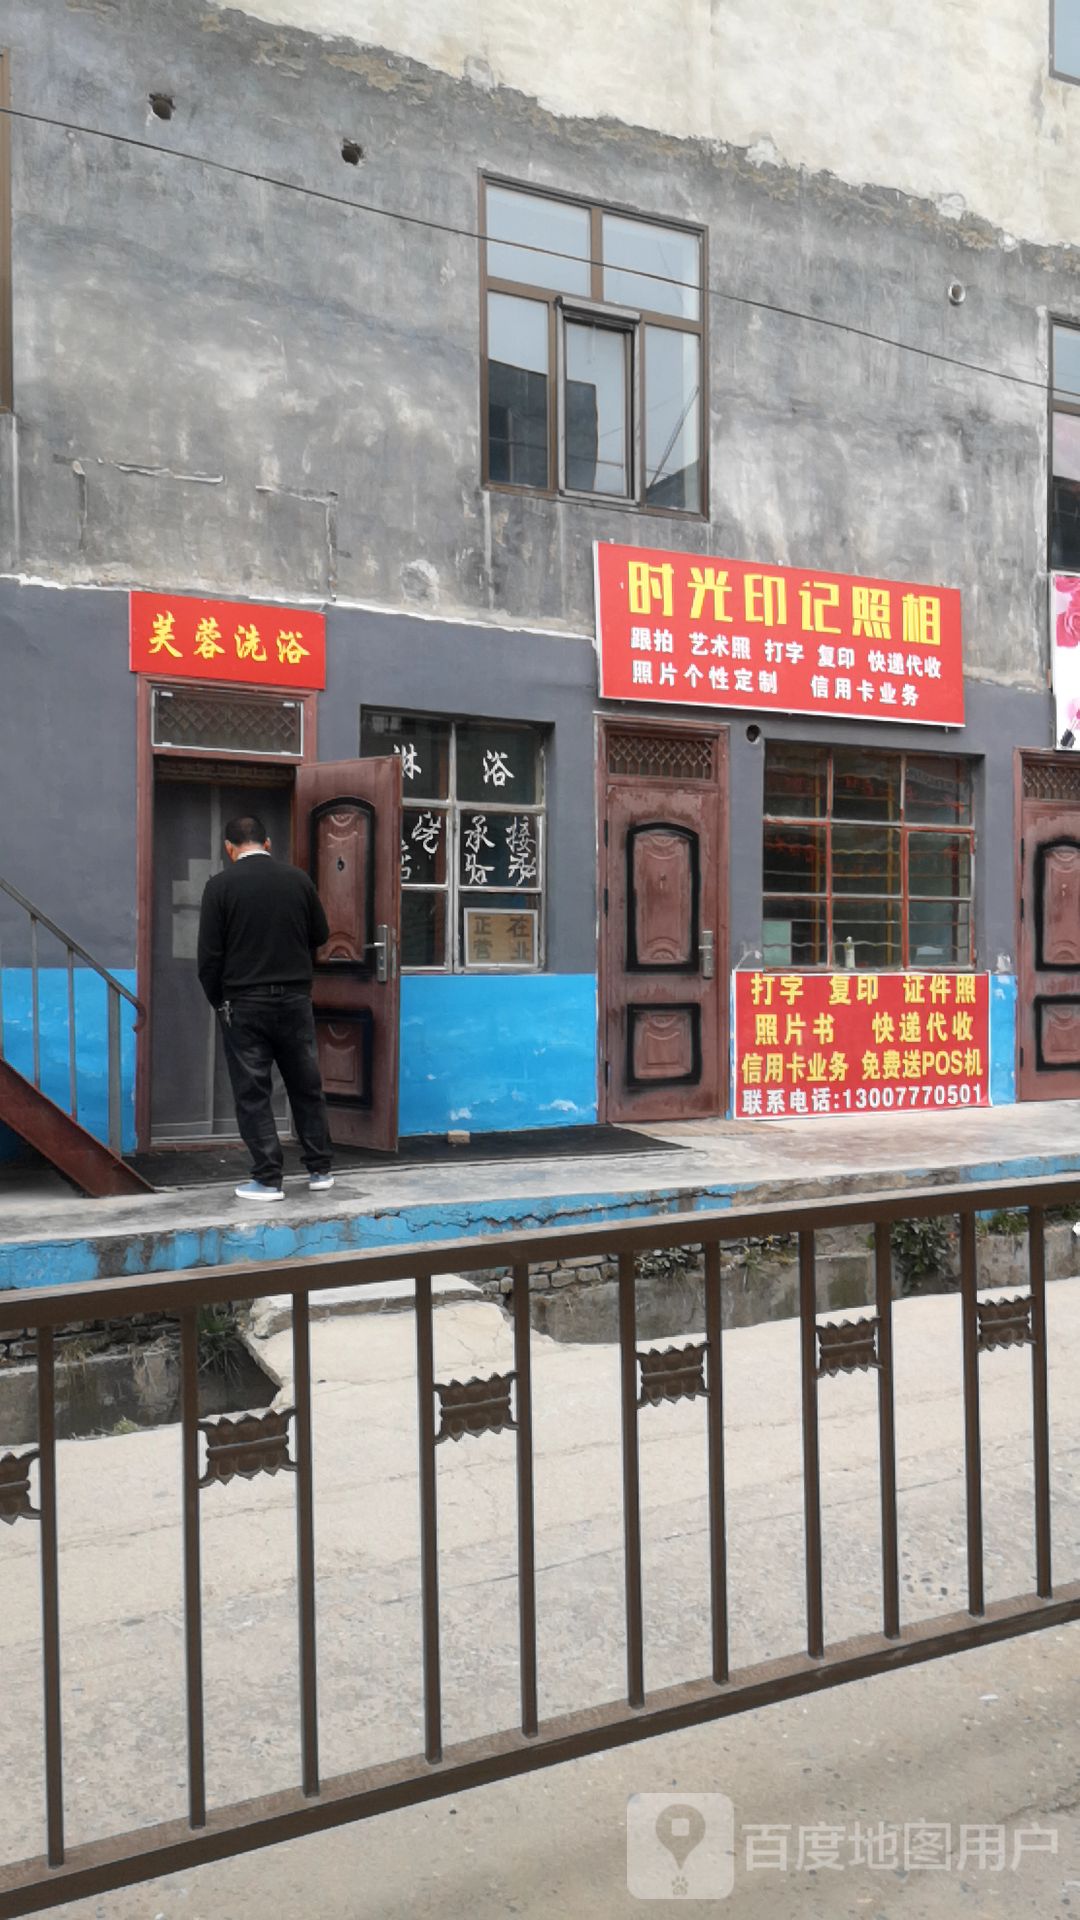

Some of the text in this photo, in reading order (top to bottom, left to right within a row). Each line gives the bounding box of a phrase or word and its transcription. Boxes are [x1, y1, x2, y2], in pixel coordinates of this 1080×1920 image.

[627, 560, 942, 646] 时光印记照相
[148, 610, 311, 664] 芙蓉洗浴
[630, 627, 943, 679] 跟拍 艺术照 打字 复印 快递代收
[632, 660, 920, 707] 照片个性定制 信用卡业务
[751, 973, 977, 1006] 打字 复印 证件照
[755, 1011, 974, 1046] 照片书 快递代收
[742, 1048, 983, 1085] 信用卡业务 免费送POS机
[742, 1083, 982, 1115] 联系电话:13007770501
